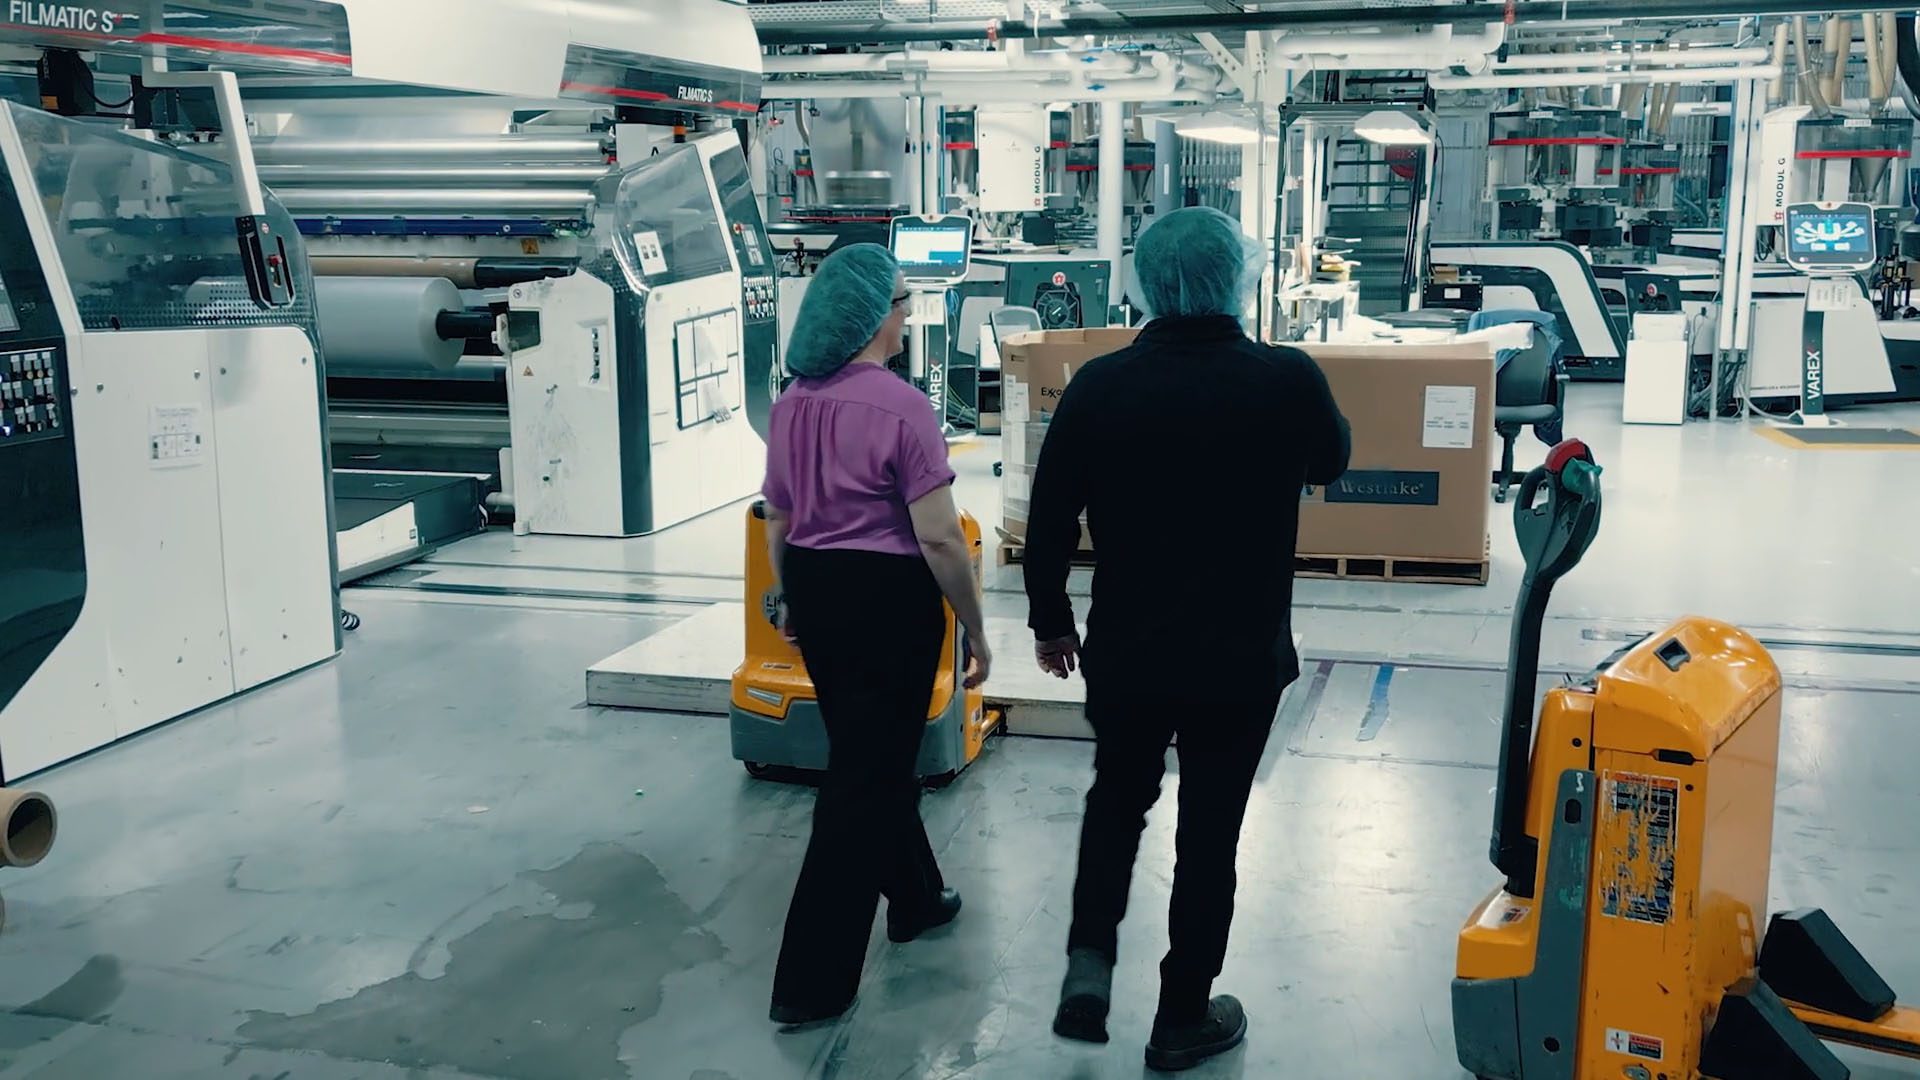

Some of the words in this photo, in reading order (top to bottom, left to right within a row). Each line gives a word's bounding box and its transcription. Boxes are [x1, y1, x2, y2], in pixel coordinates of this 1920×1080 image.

[9, 0, 97, 31] FILMATIC
[101, 10, 114, 33] S
[677, 86, 707, 102] FILMATIC
[707, 90, 713, 103] S
[1777, 157, 1787, 166] G
[1775, 169, 1785, 207] MODUL
[929, 363, 943, 411] VAREX
[1807, 350, 1820, 400] VAREX
[1040, 386, 1065, 399] Exxo
